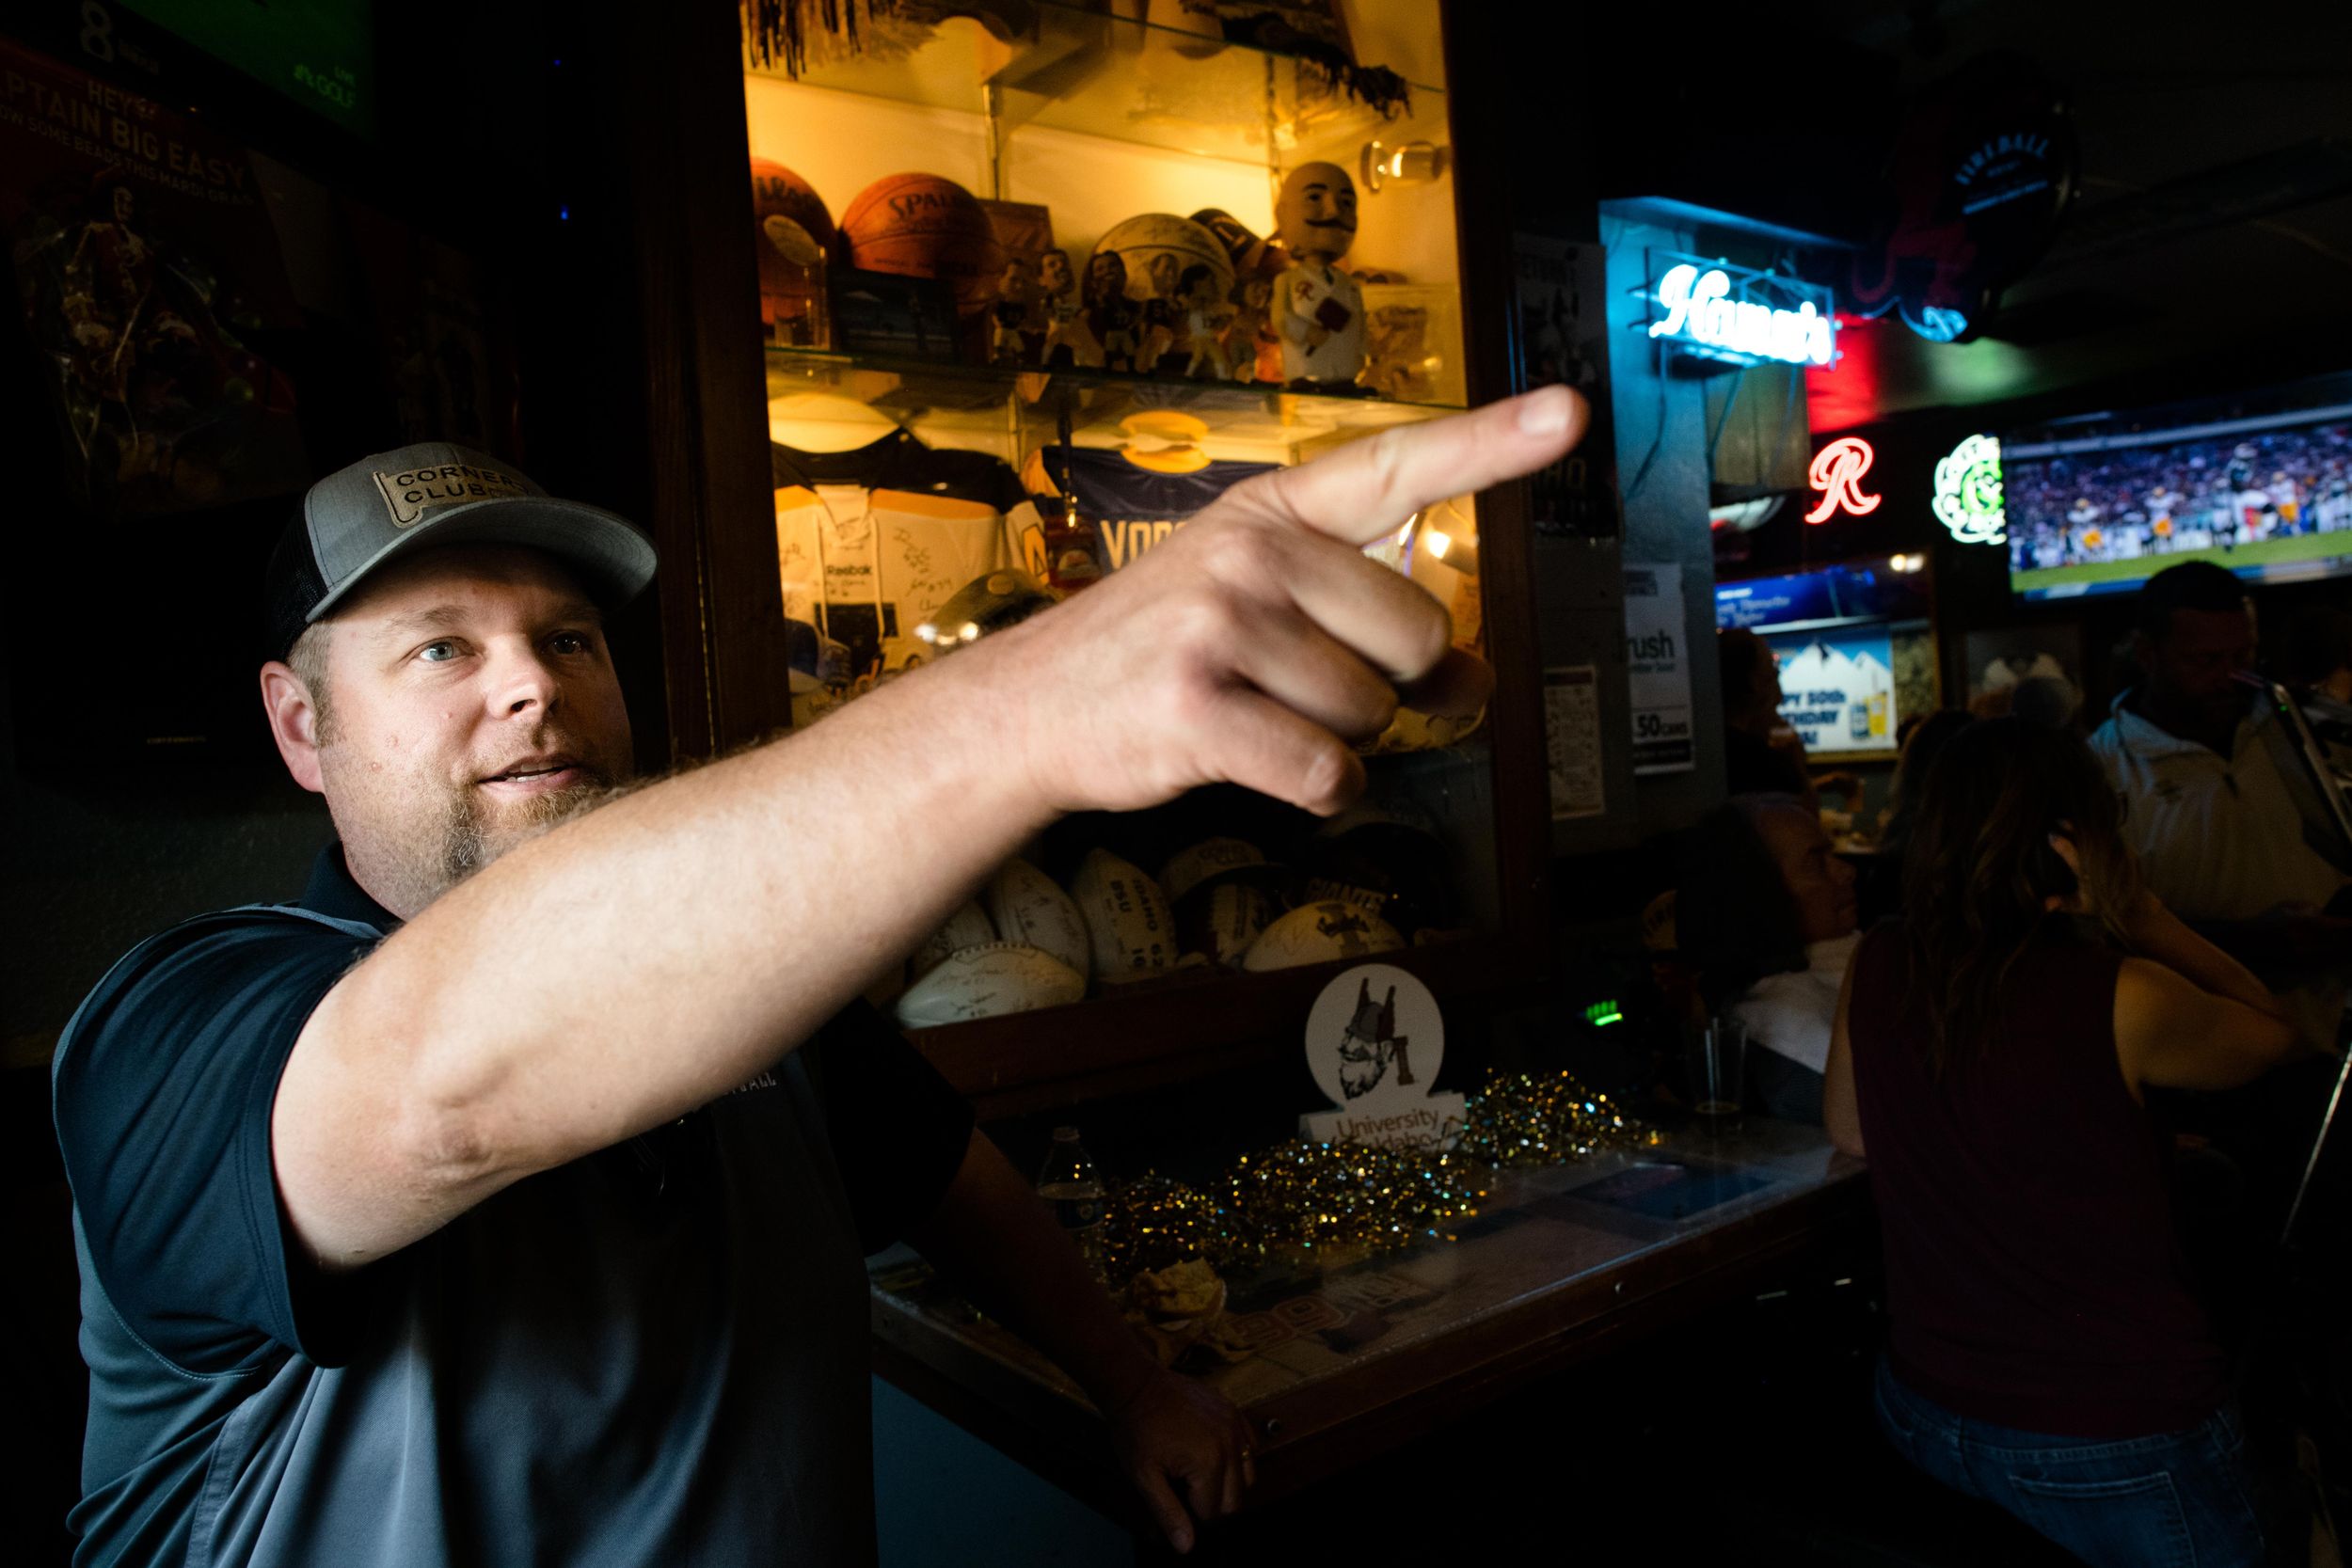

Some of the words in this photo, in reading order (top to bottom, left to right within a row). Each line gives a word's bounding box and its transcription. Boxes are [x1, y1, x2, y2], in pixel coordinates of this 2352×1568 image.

[316, 74, 357, 109] GOLF
[0, 70, 103, 140] PTAIN
[111, 117, 160, 162] BIG
[168, 140, 246, 190] EASY
[27, 115, 71, 147] SOME
[73, 135, 124, 167] BEADS
[123, 157, 158, 181] THIS
[159, 171, 205, 199] MARDI
[208, 188, 255, 206] GRAS
[396, 467, 514, 488] CORNER
[405, 483, 486, 503] CLUB
[1804, 437, 1882, 524] R
[1100, 520, 1187, 570] VO
[827, 564, 872, 576] Reebok
[1110, 879, 1132, 912] BSU
[1132, 879, 1158, 931] IDAHO
[1336, 1109, 1438, 1138] University
